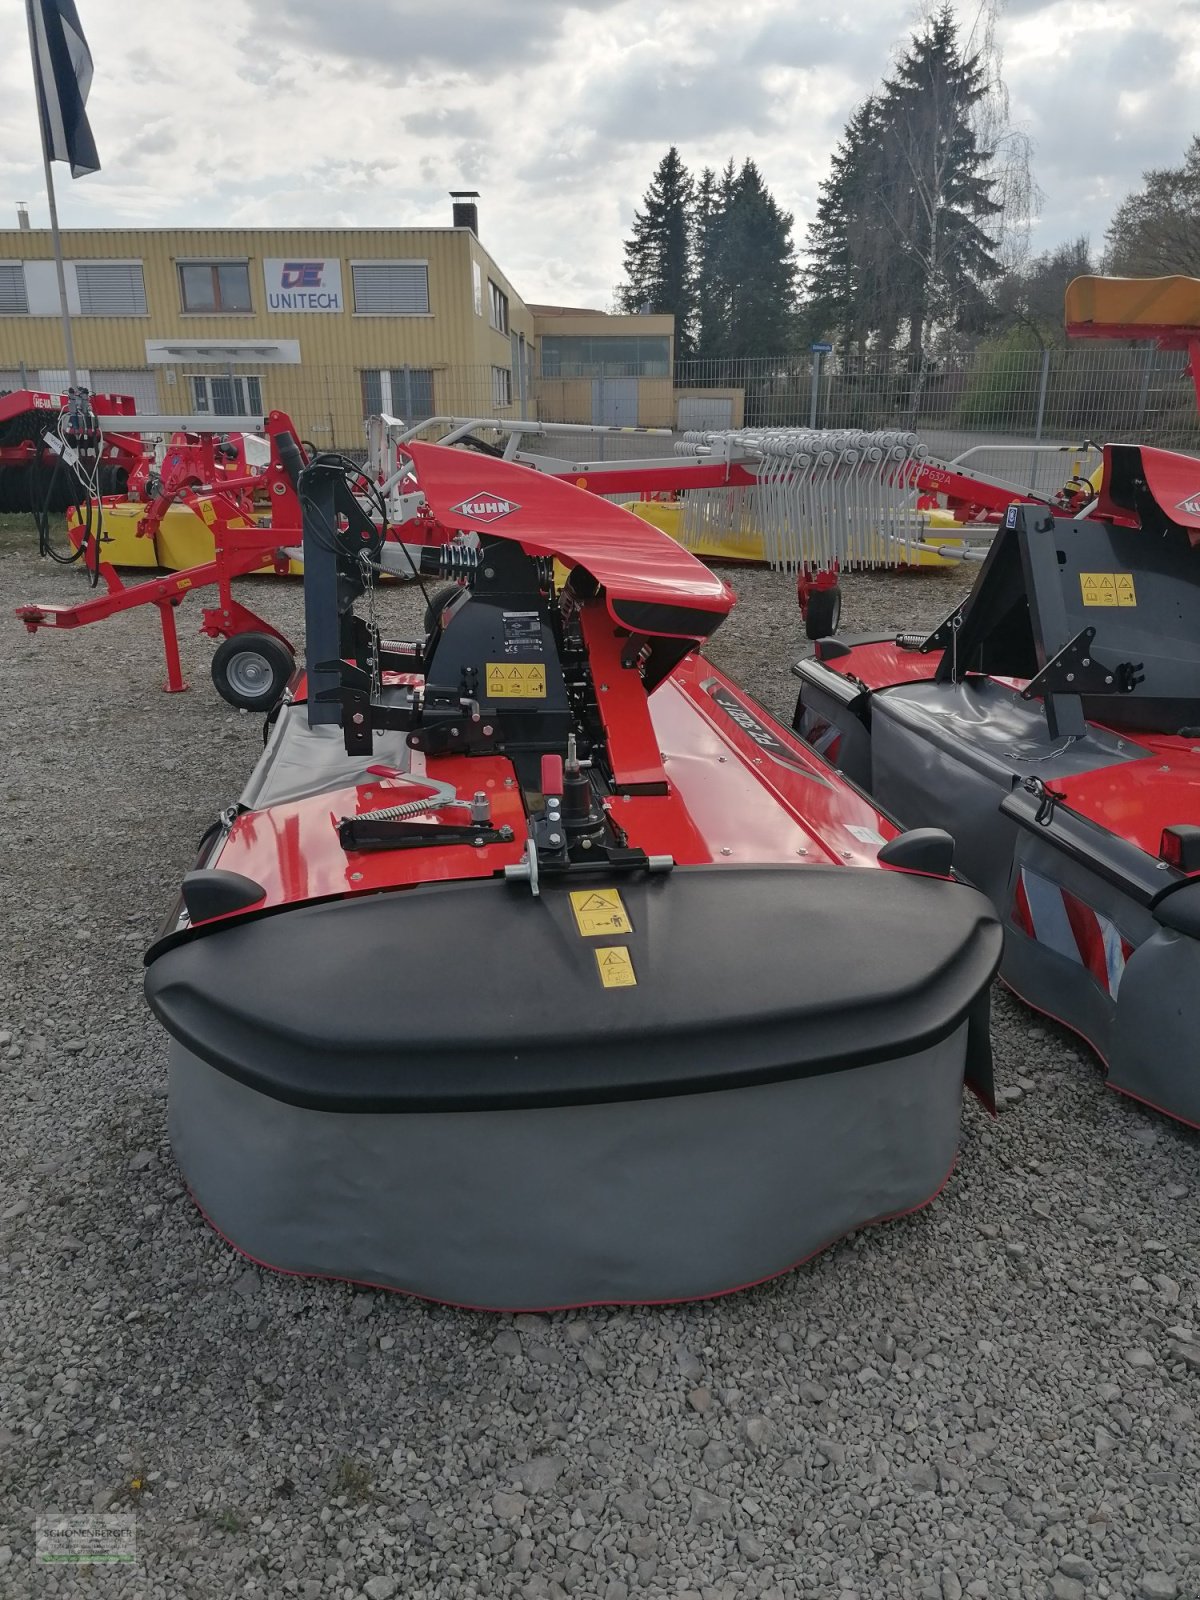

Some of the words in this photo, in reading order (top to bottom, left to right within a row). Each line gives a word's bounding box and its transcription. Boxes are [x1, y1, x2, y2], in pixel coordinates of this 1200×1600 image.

[269, 293, 338, 309] UNITECH
[34, 397, 52, 409] HE-VA
[929, 470, 945, 483] 632
[944, 475, 951, 485] A
[461, 502, 510, 515] KUHN
[716, 699, 739, 708] F
[747, 730, 780, 747] PZ
